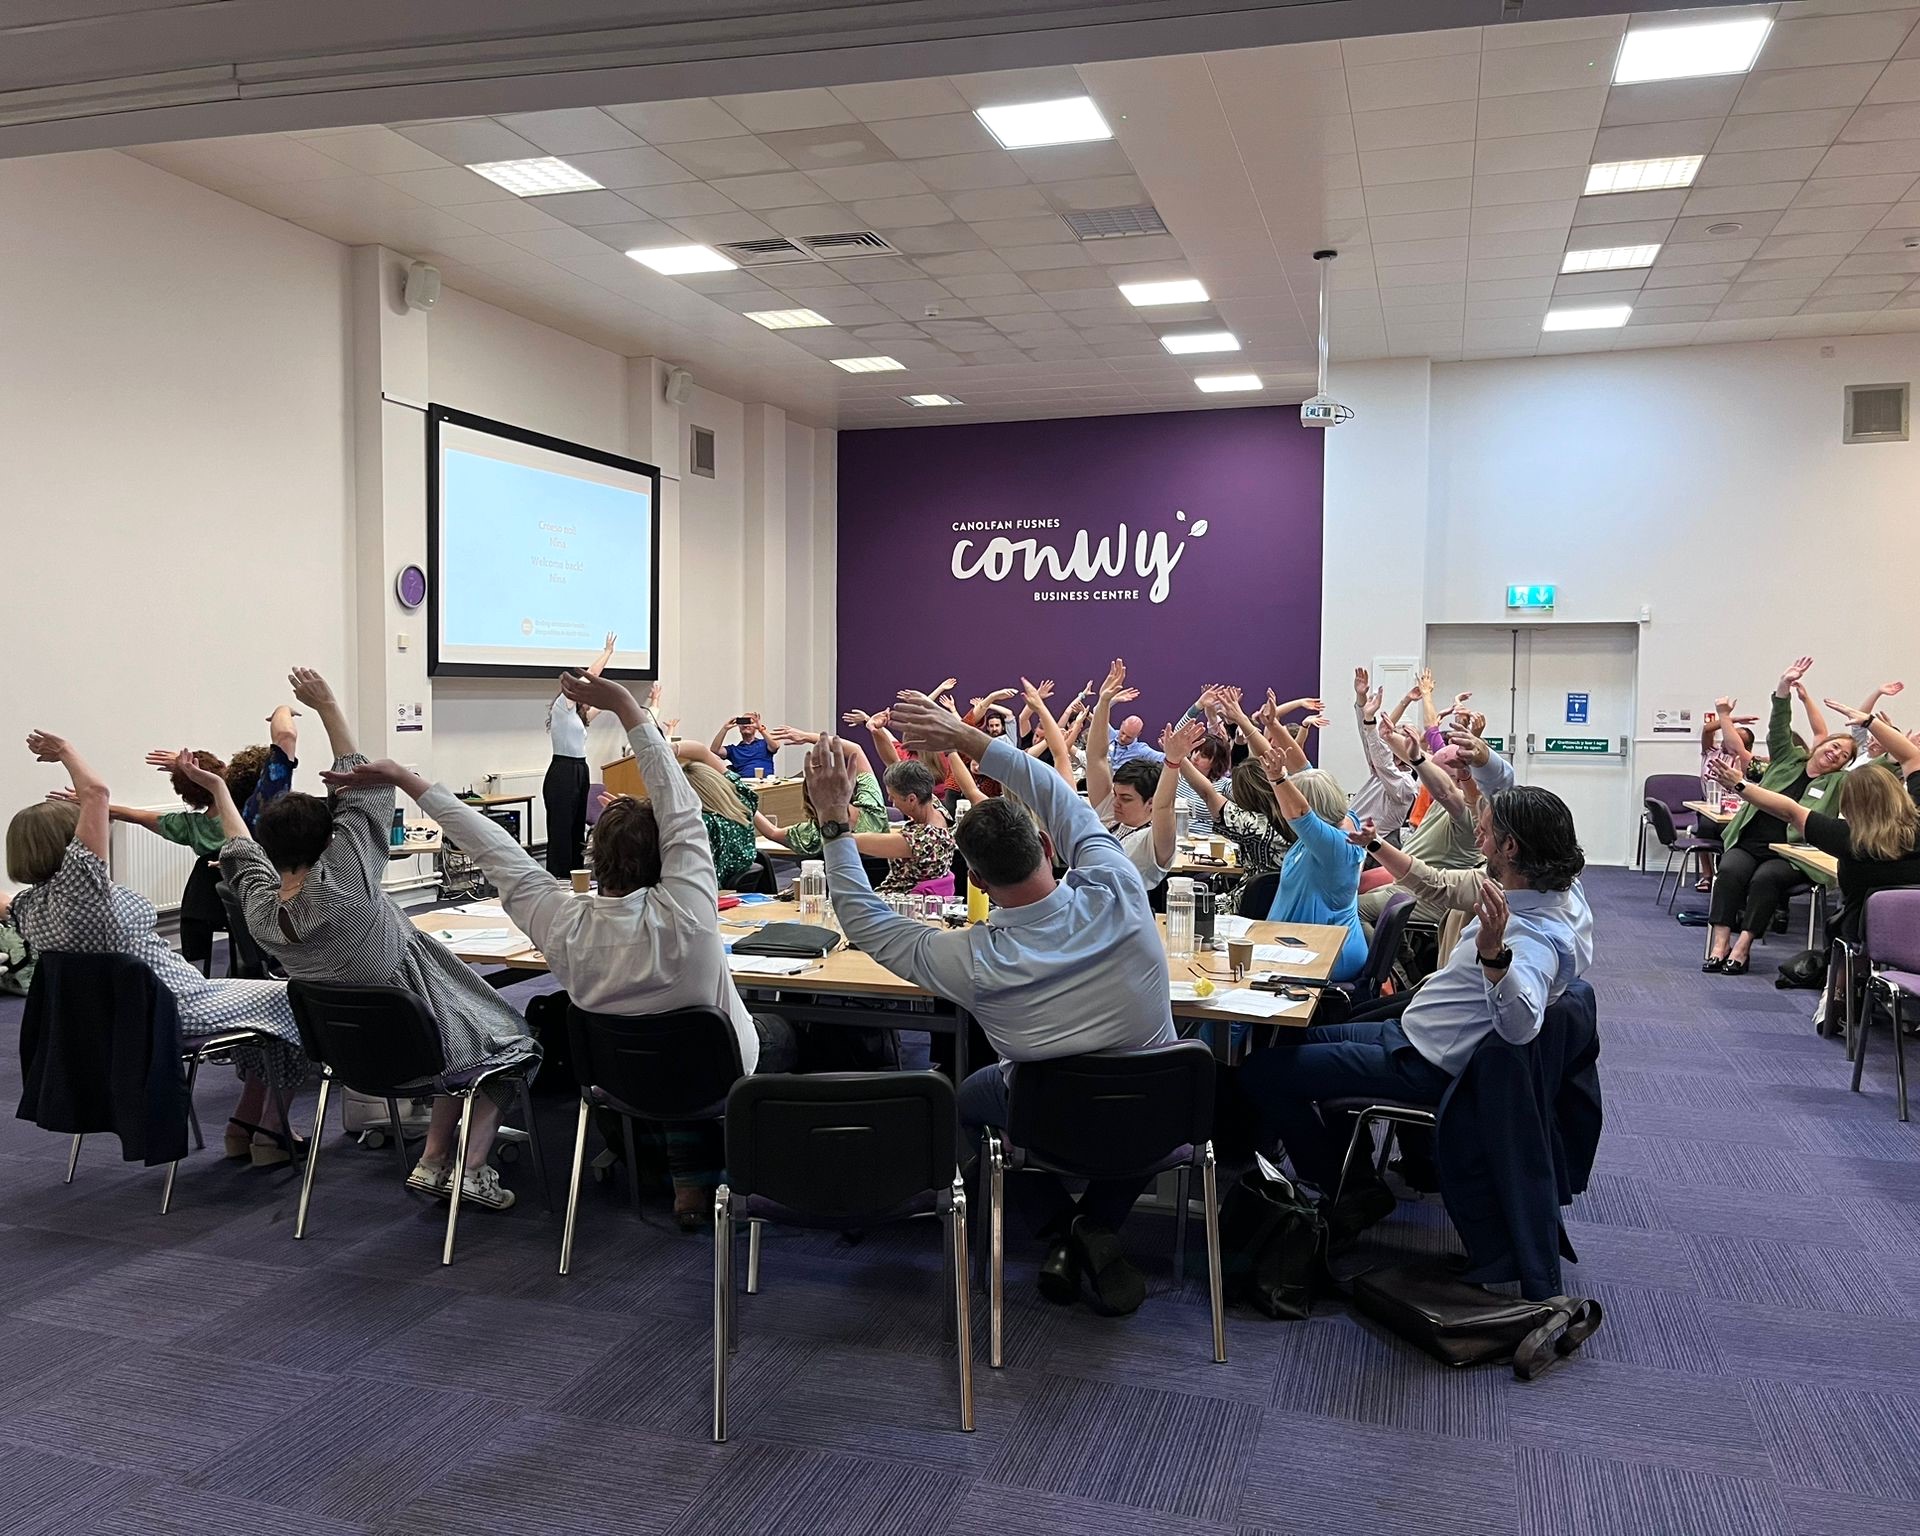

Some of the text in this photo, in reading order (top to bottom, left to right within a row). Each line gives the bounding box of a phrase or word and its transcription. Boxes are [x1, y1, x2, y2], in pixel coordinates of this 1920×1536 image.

[952, 518, 1061, 532] CANOLFAN FUSNES
[1033, 590, 1139, 601] BUSINESS CENTRE
